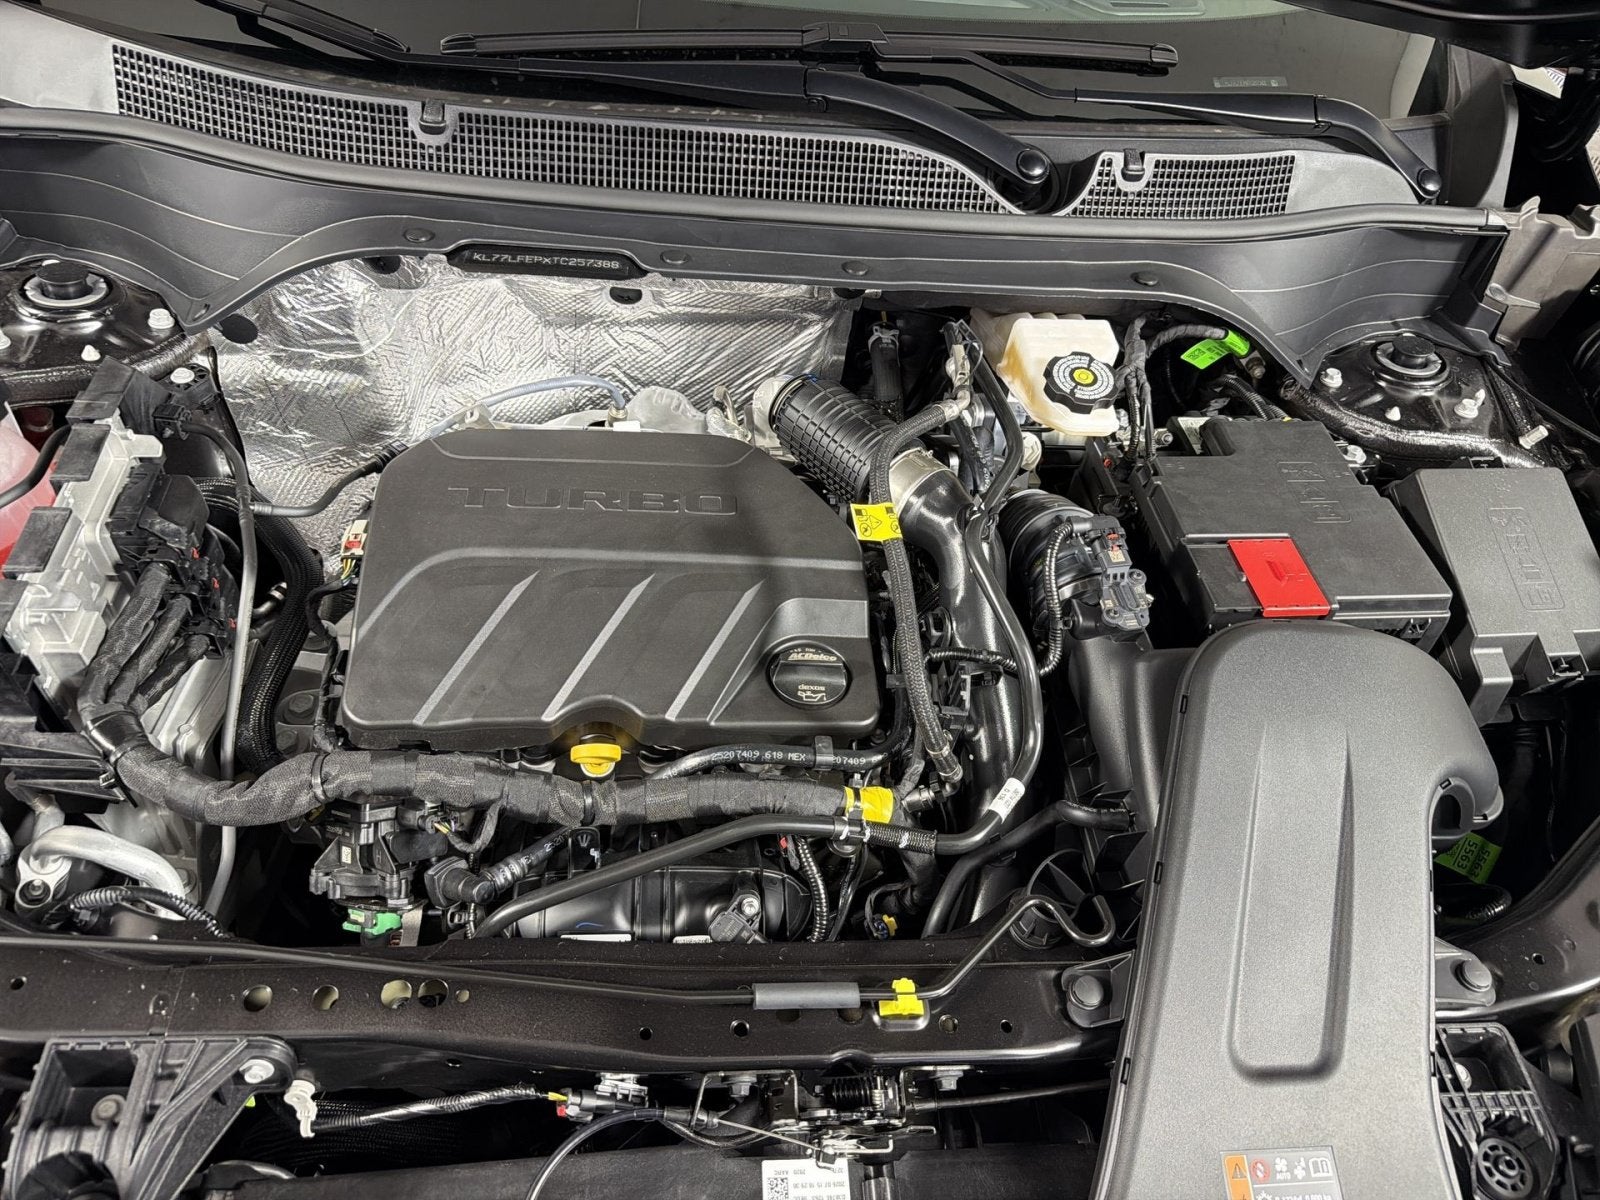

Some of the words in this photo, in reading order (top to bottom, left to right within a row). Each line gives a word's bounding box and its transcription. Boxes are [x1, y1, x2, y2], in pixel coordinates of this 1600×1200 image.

[473, 252, 620, 269] KL77LFEPXTC257388
[447, 487, 738, 516] TURBO
[764, 750, 783, 760] 618
[787, 752, 806, 761] MEX
[1456, 839, 1478, 870] 5563
